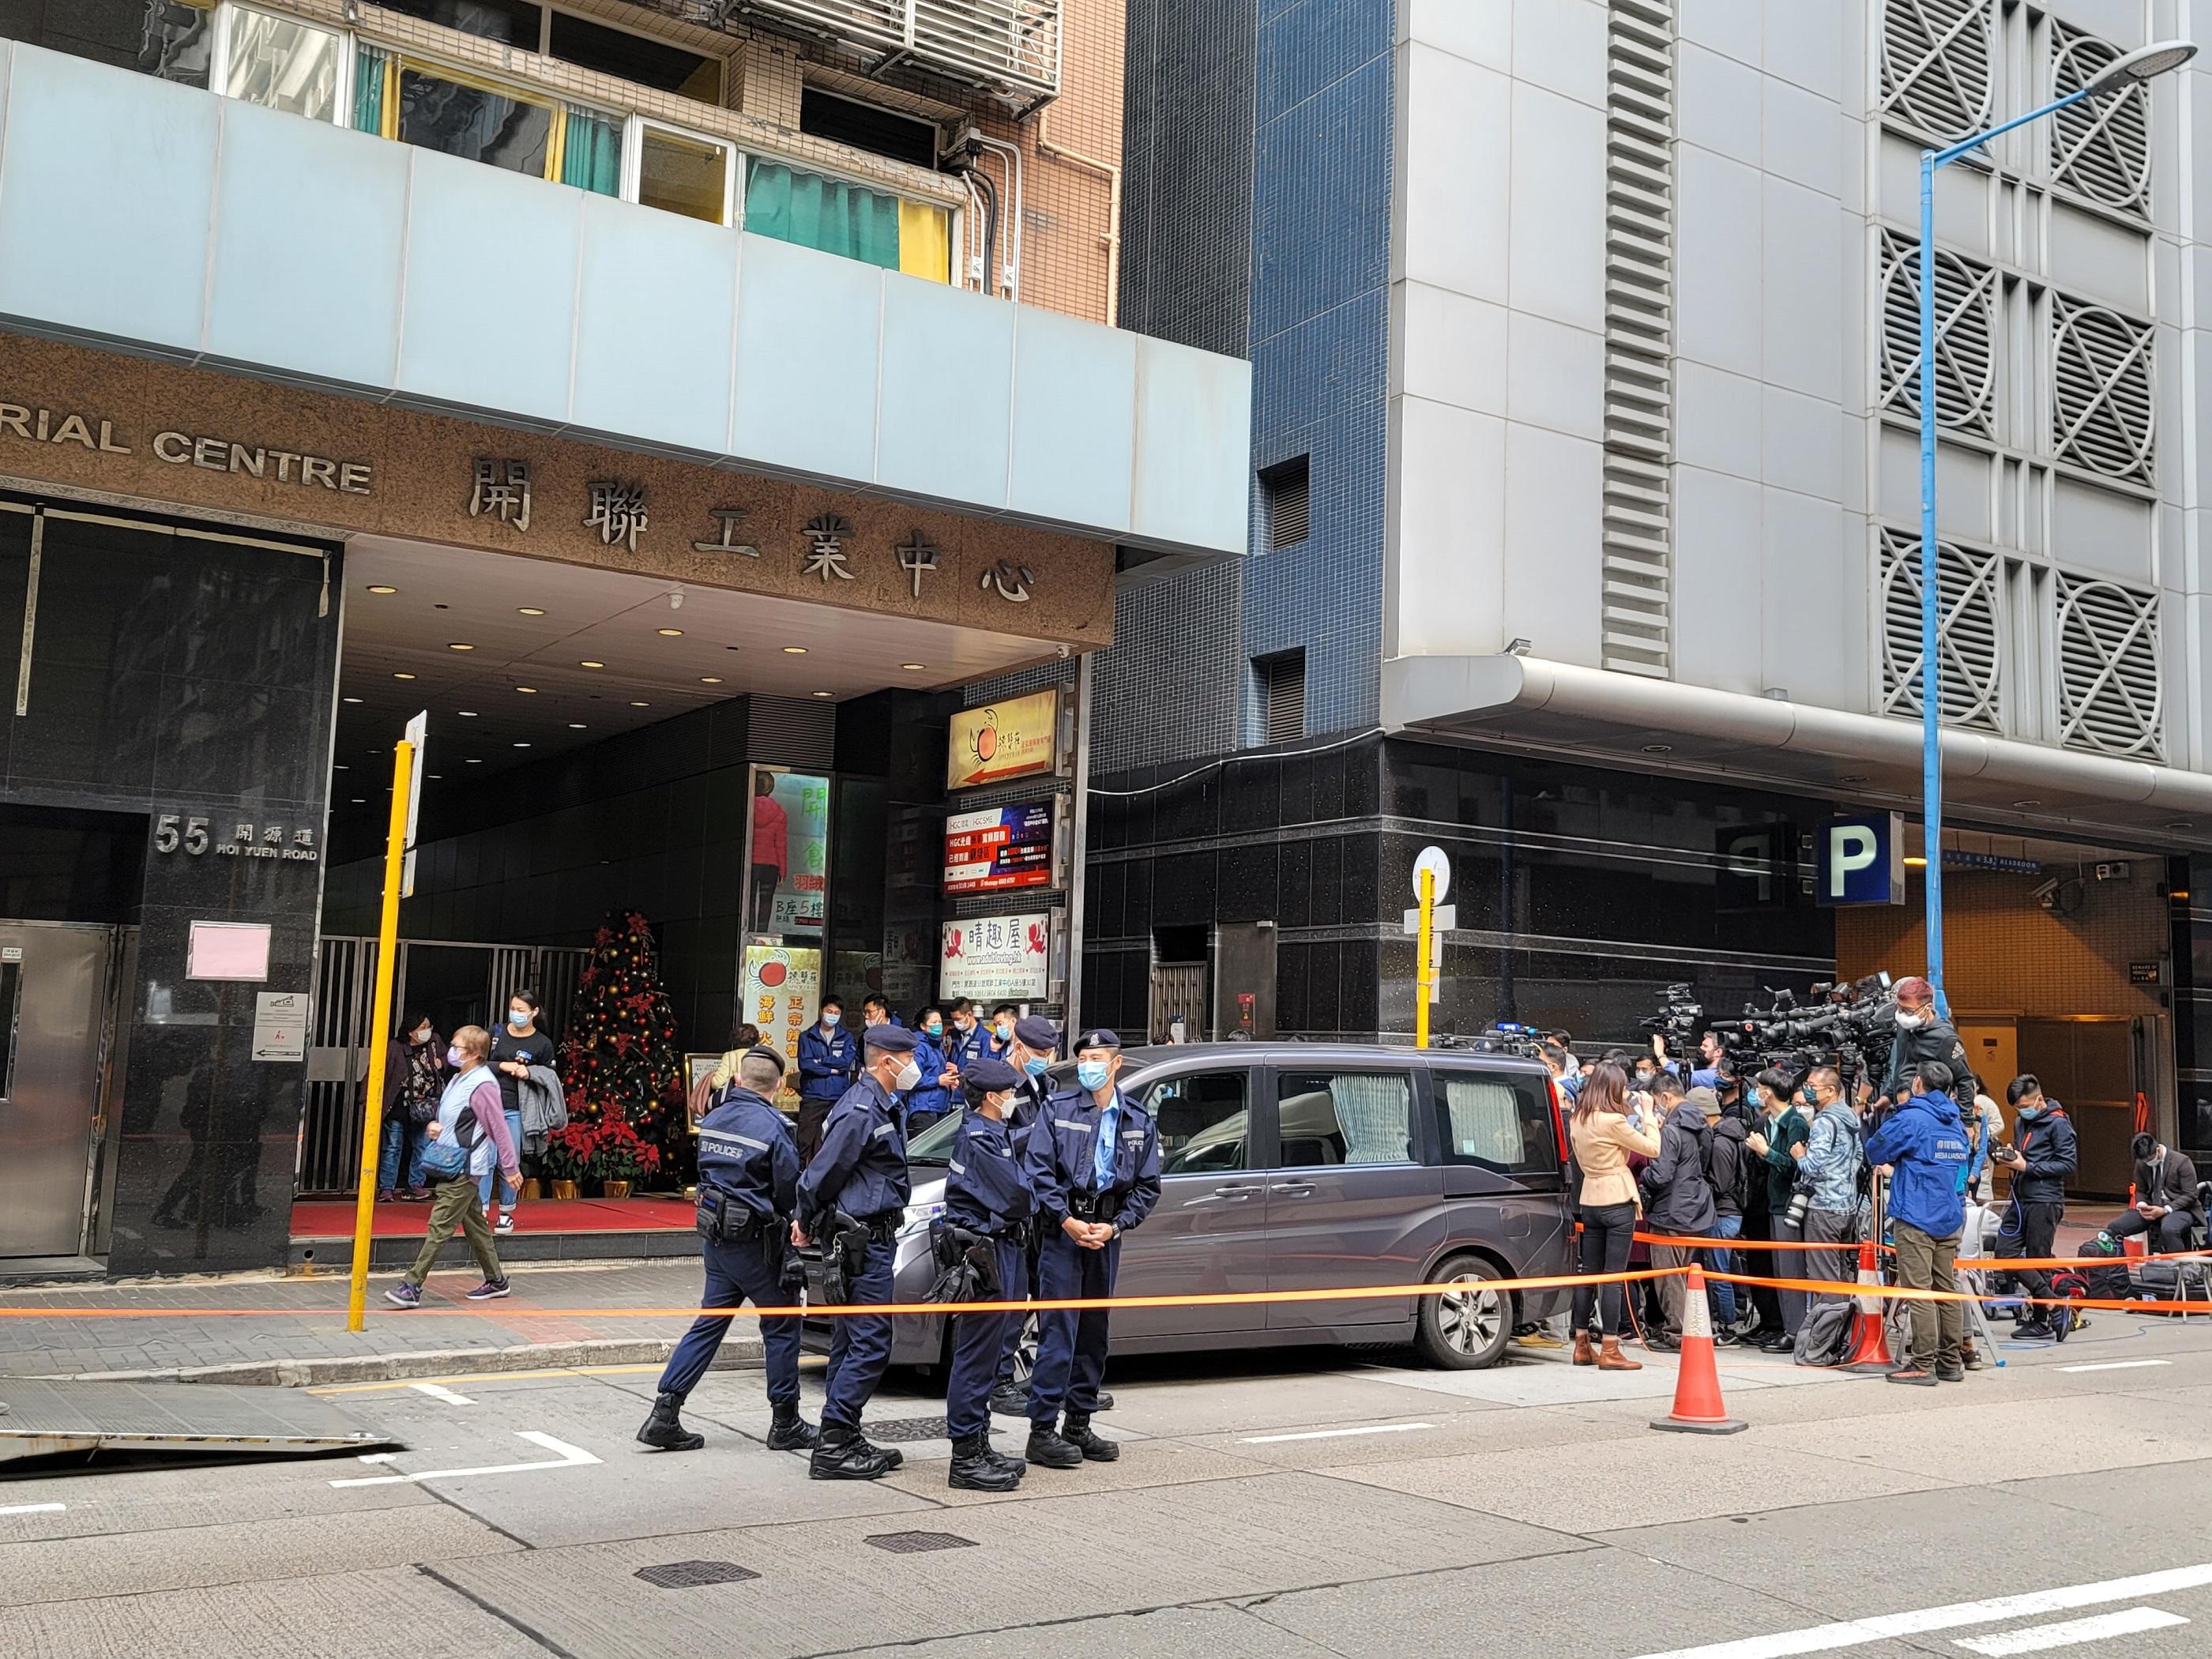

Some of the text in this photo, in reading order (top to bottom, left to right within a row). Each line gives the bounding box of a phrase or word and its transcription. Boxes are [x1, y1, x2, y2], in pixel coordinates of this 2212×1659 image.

[0, 402, 372, 495] RIAL CENTRE
[469, 458, 1035, 603] 開聯工業中心
[156, 814, 209, 856] 55
[216, 844, 318, 861] HOI YUEN ROAD
[235, 824, 314, 847] 開源道
[1830, 825, 1878, 897] P
[758, 995, 775, 1025] 海鮮
